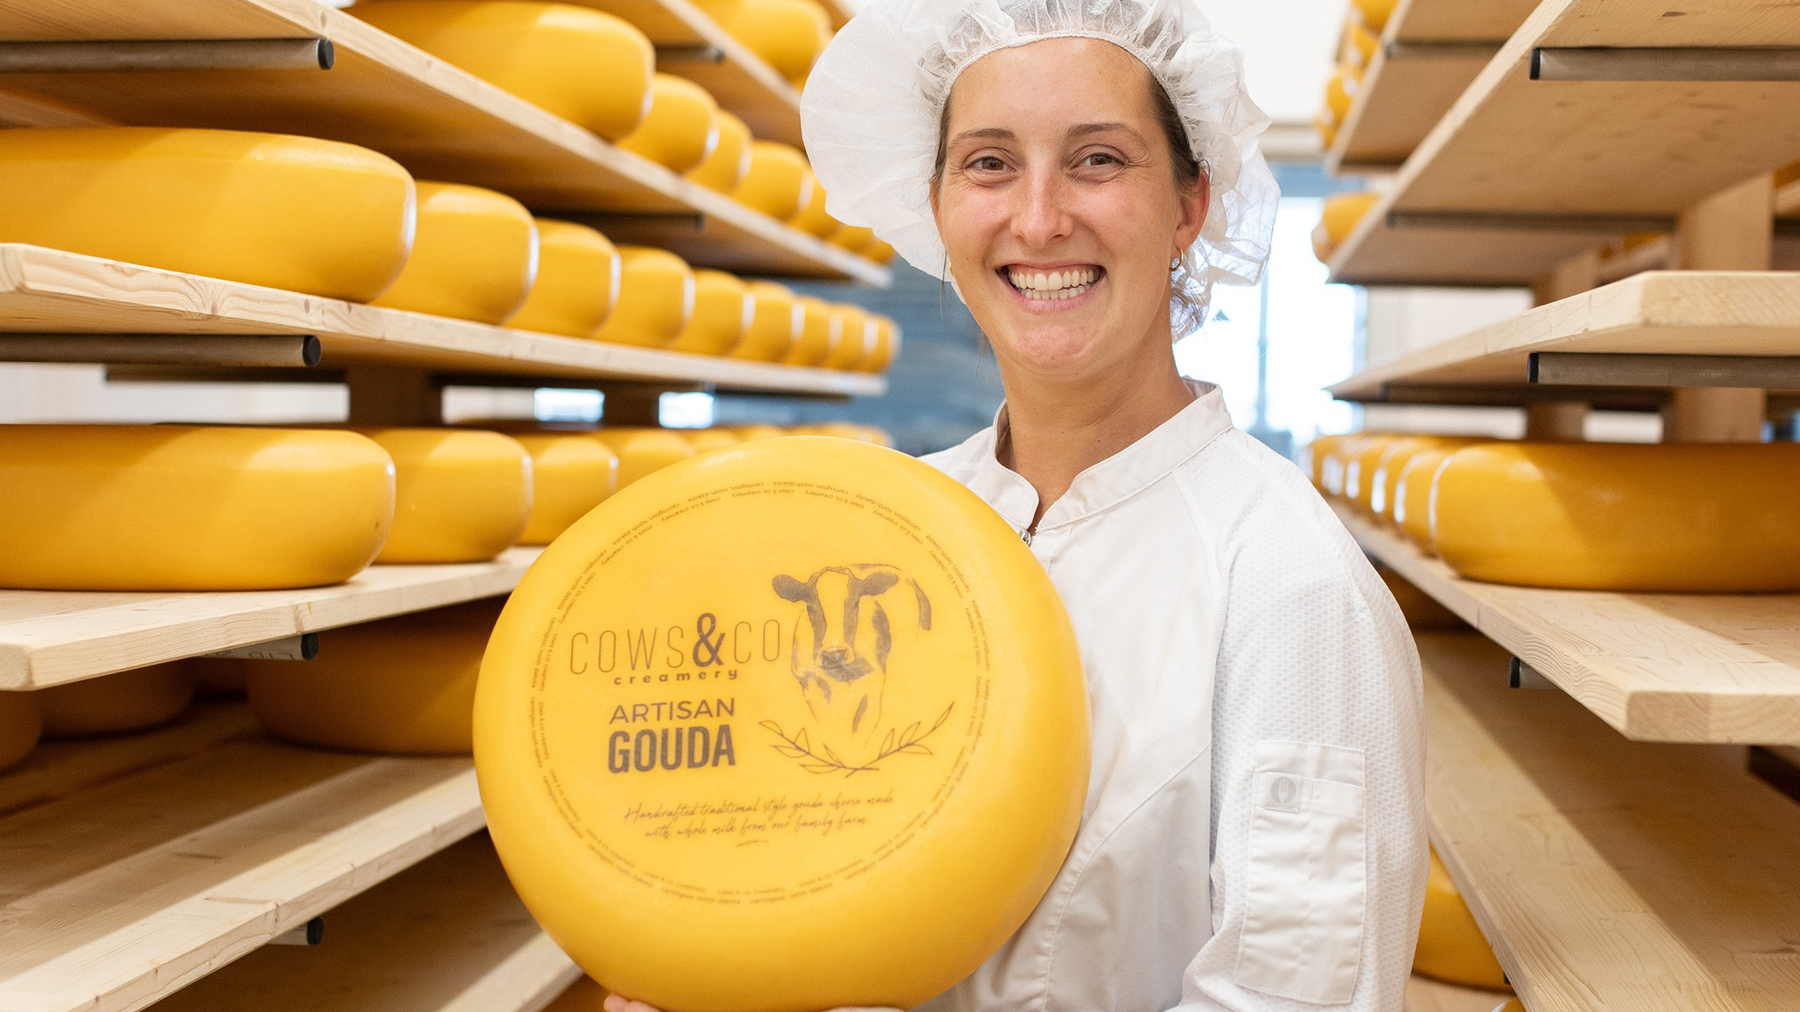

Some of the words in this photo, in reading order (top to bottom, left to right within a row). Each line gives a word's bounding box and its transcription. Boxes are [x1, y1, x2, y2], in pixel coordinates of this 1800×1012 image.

[613, 669, 738, 685] creamery
[609, 698, 735, 724] ARTISAN
[608, 724, 736, 774] GOUDA
[623, 802, 699, 824] Handcrafted
[700, 797, 760, 815] traditional
[763, 795, 787, 820] style
[788, 793, 823, 819] gouda
[829, 792, 861, 810] cheese
[867, 788, 893, 806] made
[645, 821, 672, 839] with
[677, 819, 707, 838] whole
[712, 817, 736, 834] milk
[740, 818, 766, 837] from
[772, 821, 789, 829] our
[794, 811, 833, 836] family
[837, 811, 866, 830] farm
